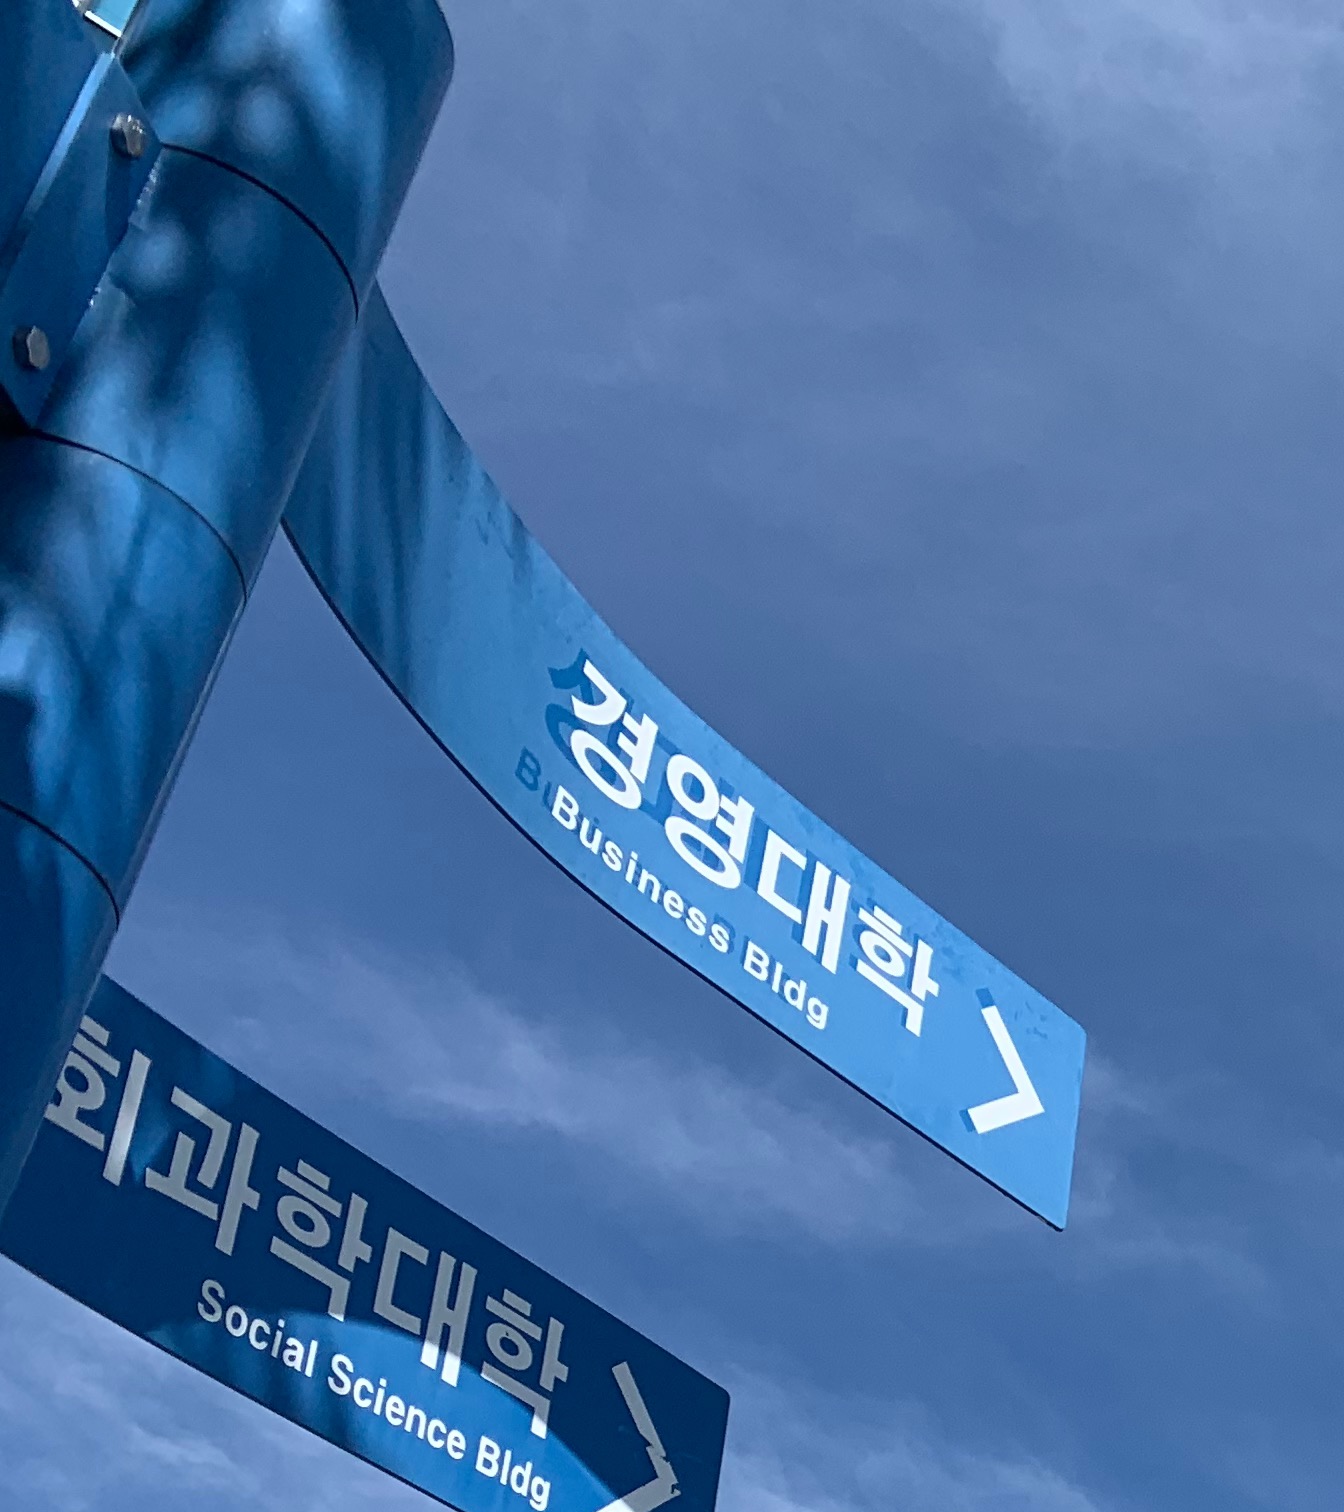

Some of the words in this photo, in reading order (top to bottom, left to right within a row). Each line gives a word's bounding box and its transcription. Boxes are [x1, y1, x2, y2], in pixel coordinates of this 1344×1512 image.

[551, 784, 731, 954] Business
[742, 938, 831, 1030] Bldg
[569, 658, 939, 1038] 경영대학
[196, 1279, 317, 1379] Social
[327, 1352, 468, 1462] Science
[475, 1435, 551, 1512] Bldg
